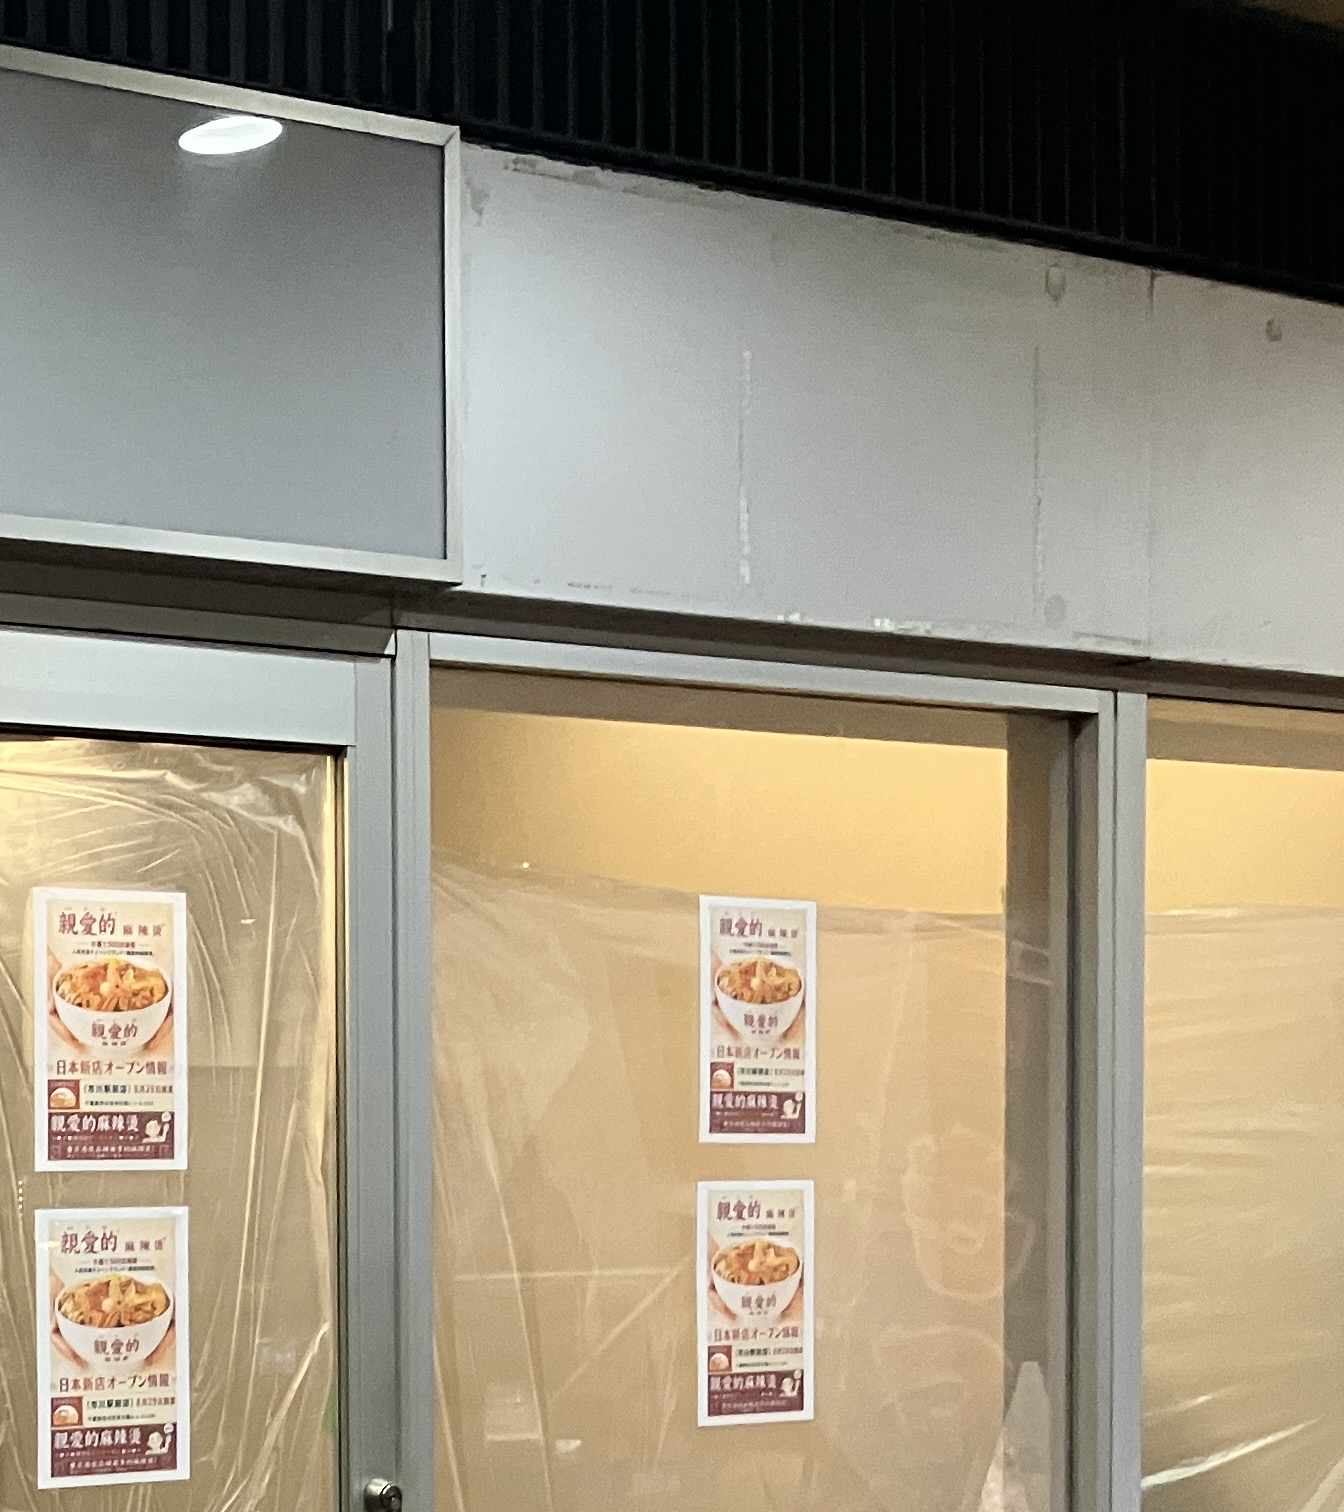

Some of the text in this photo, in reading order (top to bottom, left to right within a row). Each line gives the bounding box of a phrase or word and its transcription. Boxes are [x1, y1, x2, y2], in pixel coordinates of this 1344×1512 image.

[59, 912, 116, 936] 親愛的
[719, 918, 762, 938] 親愛的
[56, 1060, 168, 1076] 日本新店オープン情報
[716, 1199, 761, 1221] 親愛的
[61, 1230, 118, 1255] 親愛的
[59, 1373, 170, 1393] 日本新店オープン情報
